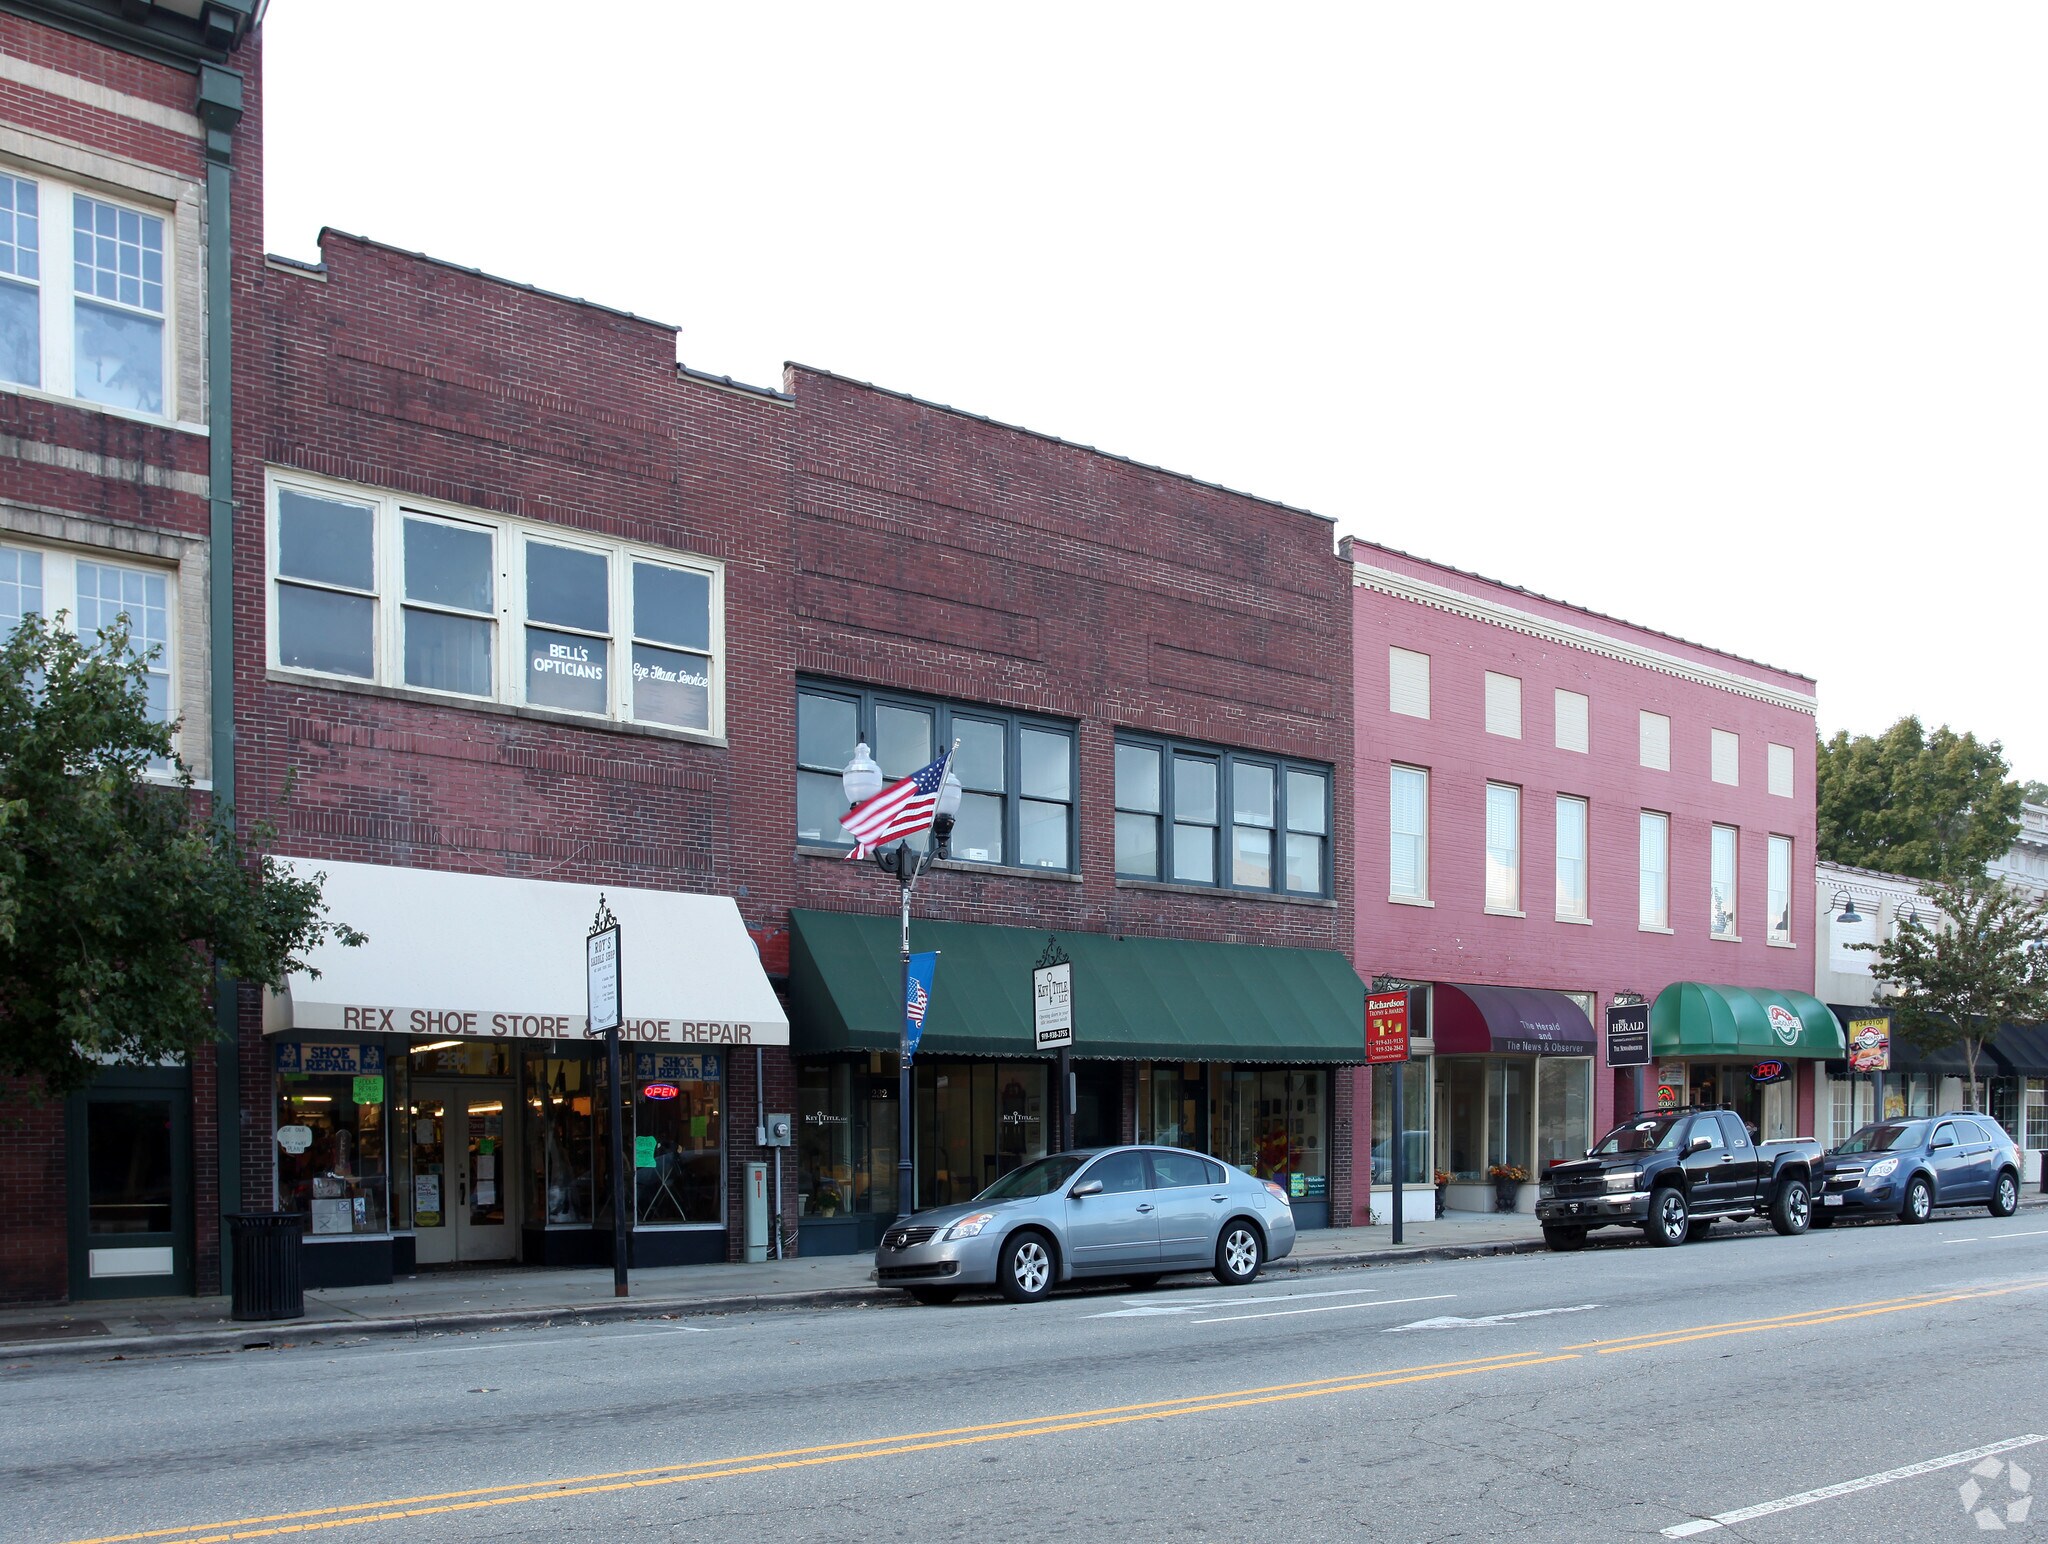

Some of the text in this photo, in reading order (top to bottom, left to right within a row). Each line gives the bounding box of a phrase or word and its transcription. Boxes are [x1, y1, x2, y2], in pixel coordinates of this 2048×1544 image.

[550, 644, 588, 662] BELL'S
[534, 658, 602, 680] OPTICIANS
[633, 662, 648, 682] Eye
[677, 670, 708, 687] Service
[595, 937, 611, 954] ROY'S
[606, 950, 615, 962] SHOP
[1038, 984, 1048, 997] KEY
[1059, 994, 1067, 1003] LLC
[1369, 999, 1404, 1010] Richardson
[344, 1007, 394, 1031] REX
[410, 1010, 478, 1034] SHOE
[492, 1014, 570, 1038] STORE
[682, 1022, 752, 1044] REPAIR
[1520, 1020, 1560, 1030] The Herald
[1612, 1022, 1644, 1032] HERALD
[1507, 1041, 1584, 1052] The News & Observer
[311, 1047, 350, 1059] SHOE
[305, 1059, 357, 1072] REPAIR
[663, 1056, 694, 1067] SHOE
[658, 1068, 699, 1078] REPAIR
[1753, 1064, 1779, 1077] OPEN
[645, 1087, 678, 1096] OPEN
[872, 1089, 887, 1098] 232
